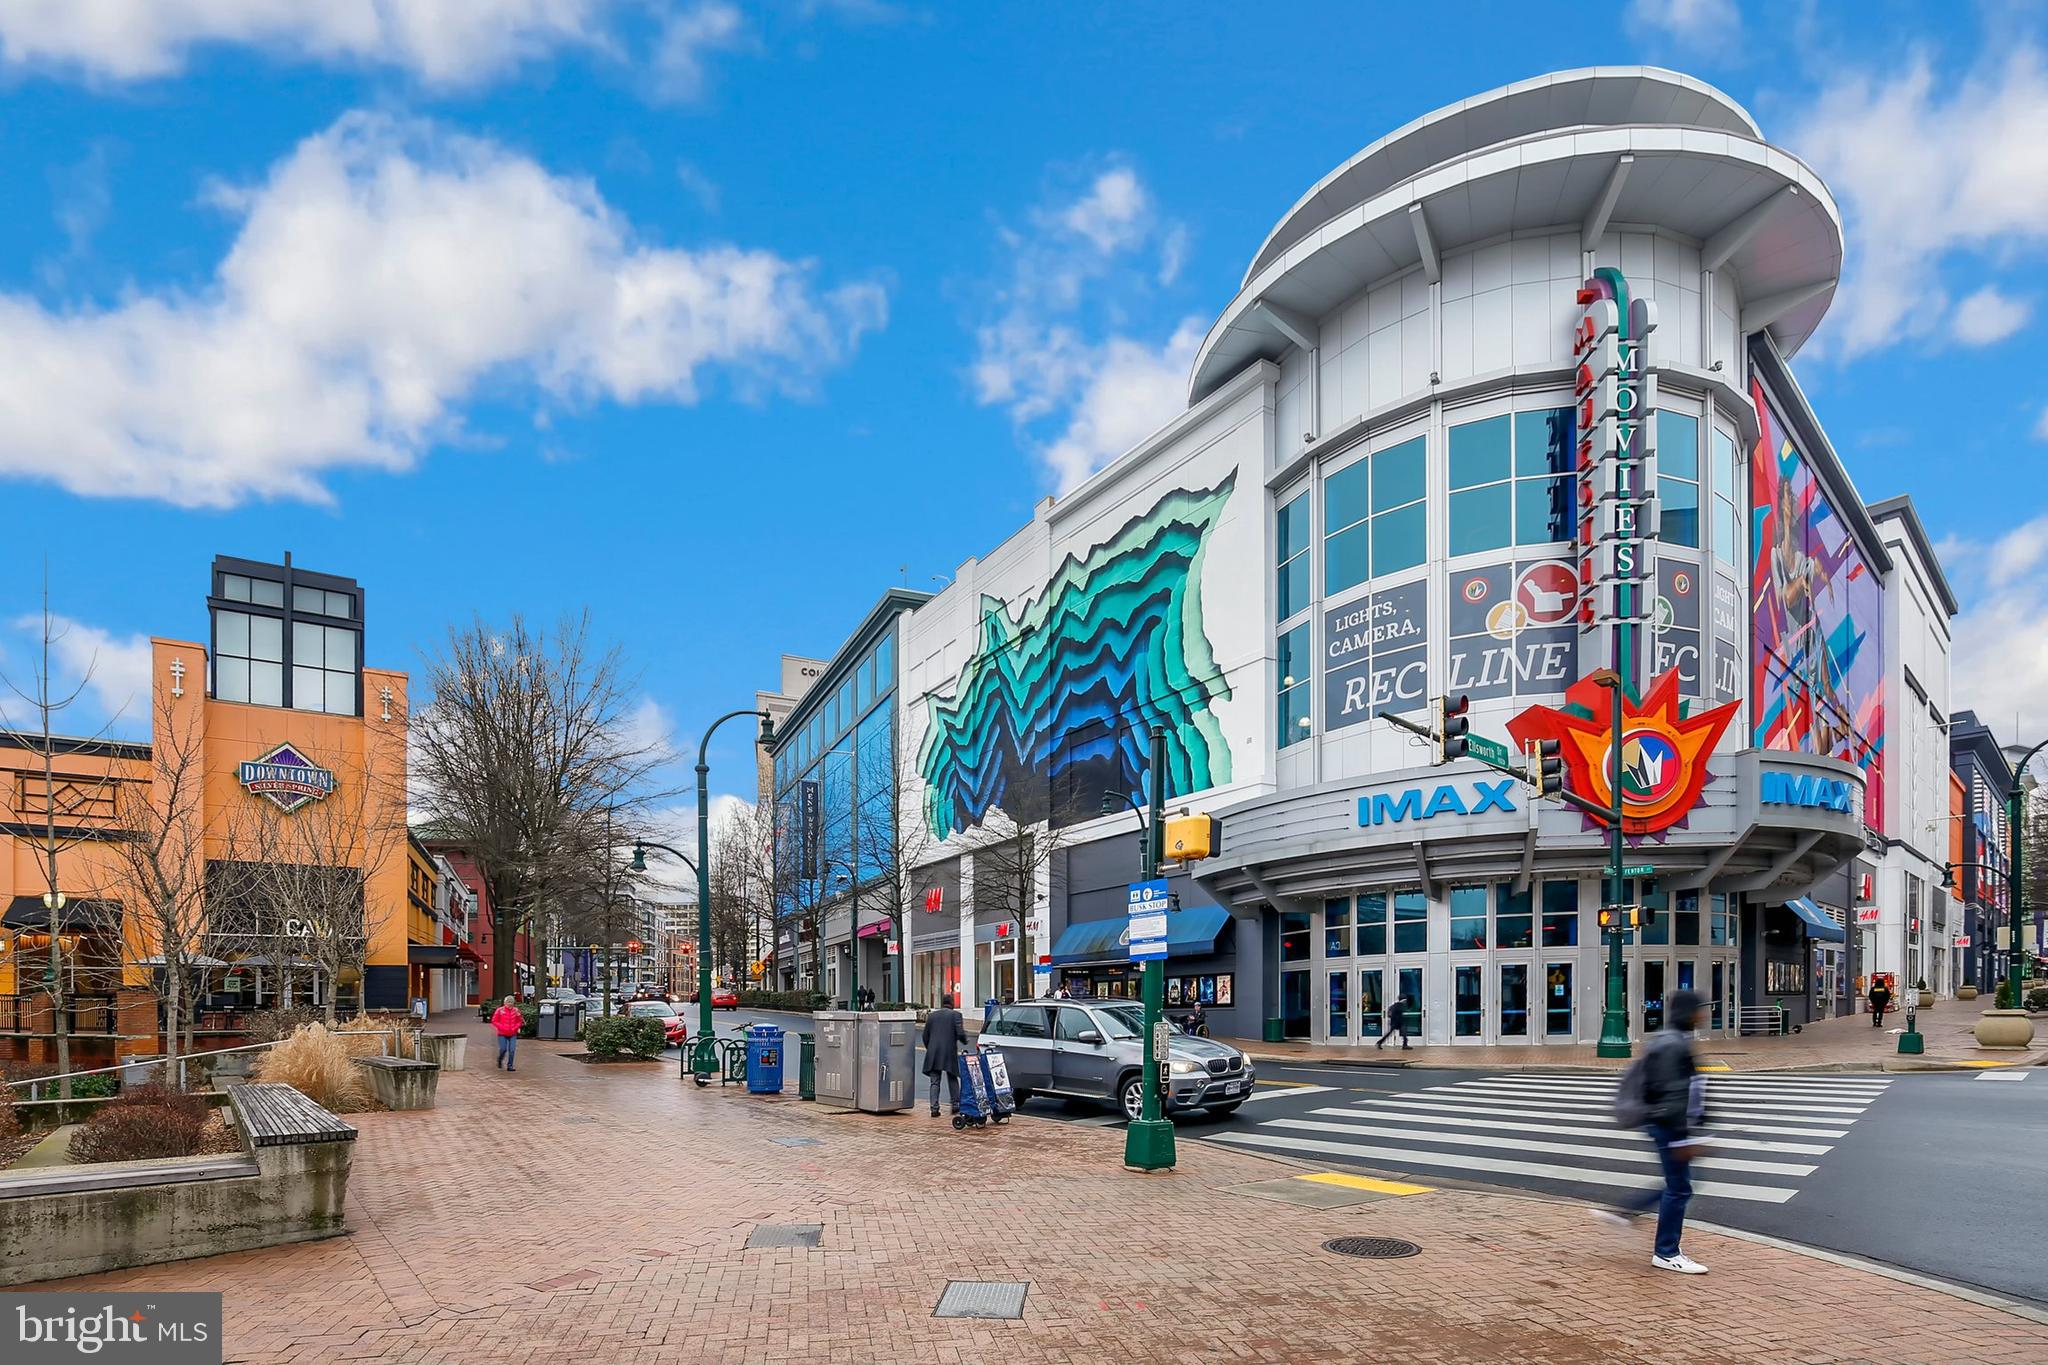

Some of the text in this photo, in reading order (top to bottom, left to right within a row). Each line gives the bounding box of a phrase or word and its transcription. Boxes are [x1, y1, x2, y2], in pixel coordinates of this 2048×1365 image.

[1614, 348, 1640, 572] MOVIES
[1335, 601, 1398, 633] LIGHTS,
[1329, 618, 1421, 658] CAMERA,
[1468, 738, 1495, 760] Ellsworth
[245, 764, 328, 788] DOWNTOWN
[1761, 771, 1853, 814] IMAX
[1358, 779, 1517, 827] IMAX
[1130, 901, 1166, 912] BUSK STOP
